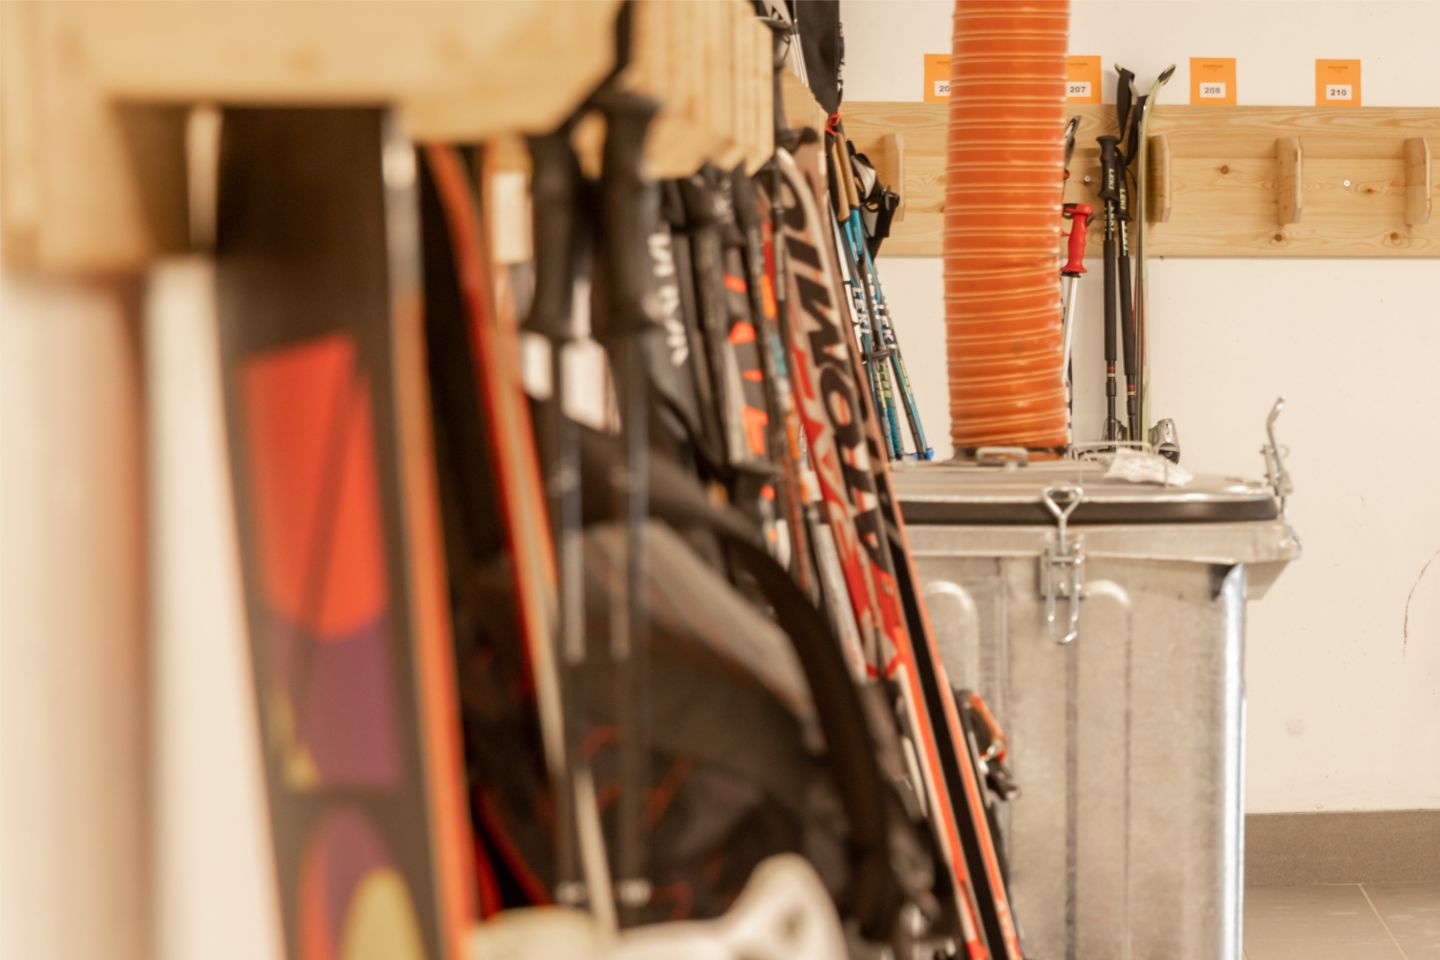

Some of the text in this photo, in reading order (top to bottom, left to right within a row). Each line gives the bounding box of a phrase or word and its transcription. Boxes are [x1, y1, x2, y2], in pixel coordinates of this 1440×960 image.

[1069, 85, 1087, 94] 207
[1203, 86, 1222, 95] 208
[1330, 88, 1347, 97] 210
